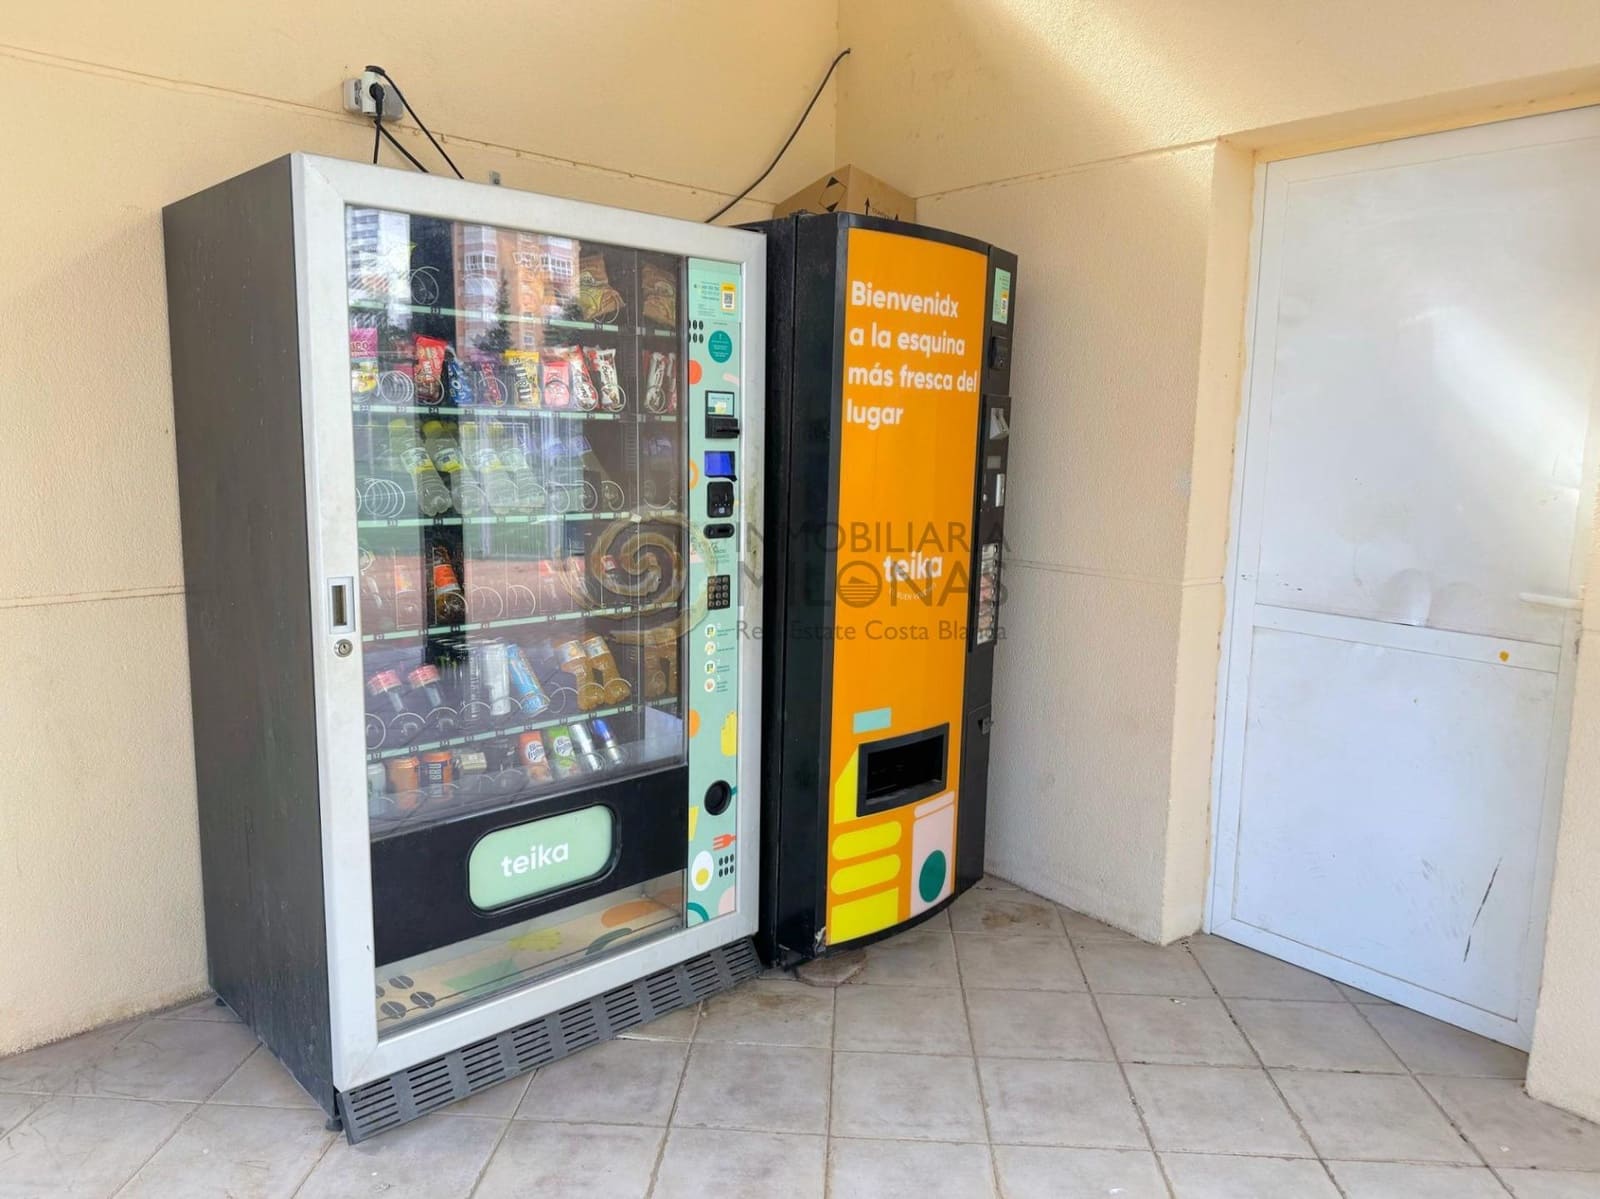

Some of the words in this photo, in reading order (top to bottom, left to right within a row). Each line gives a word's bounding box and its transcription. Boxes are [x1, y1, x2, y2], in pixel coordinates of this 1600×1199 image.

[851, 280, 959, 318] Bienvenidx
[849, 327, 864, 346] a
[871, 321, 891, 348] la
[897, 331, 965, 358] esquina
[848, 362, 893, 387] más
[899, 364, 952, 390] fresca
[957, 370, 977, 392] del
[846, 398, 904, 431] lugar
[883, 551, 943, 582] teika
[501, 843, 569, 877] teika
